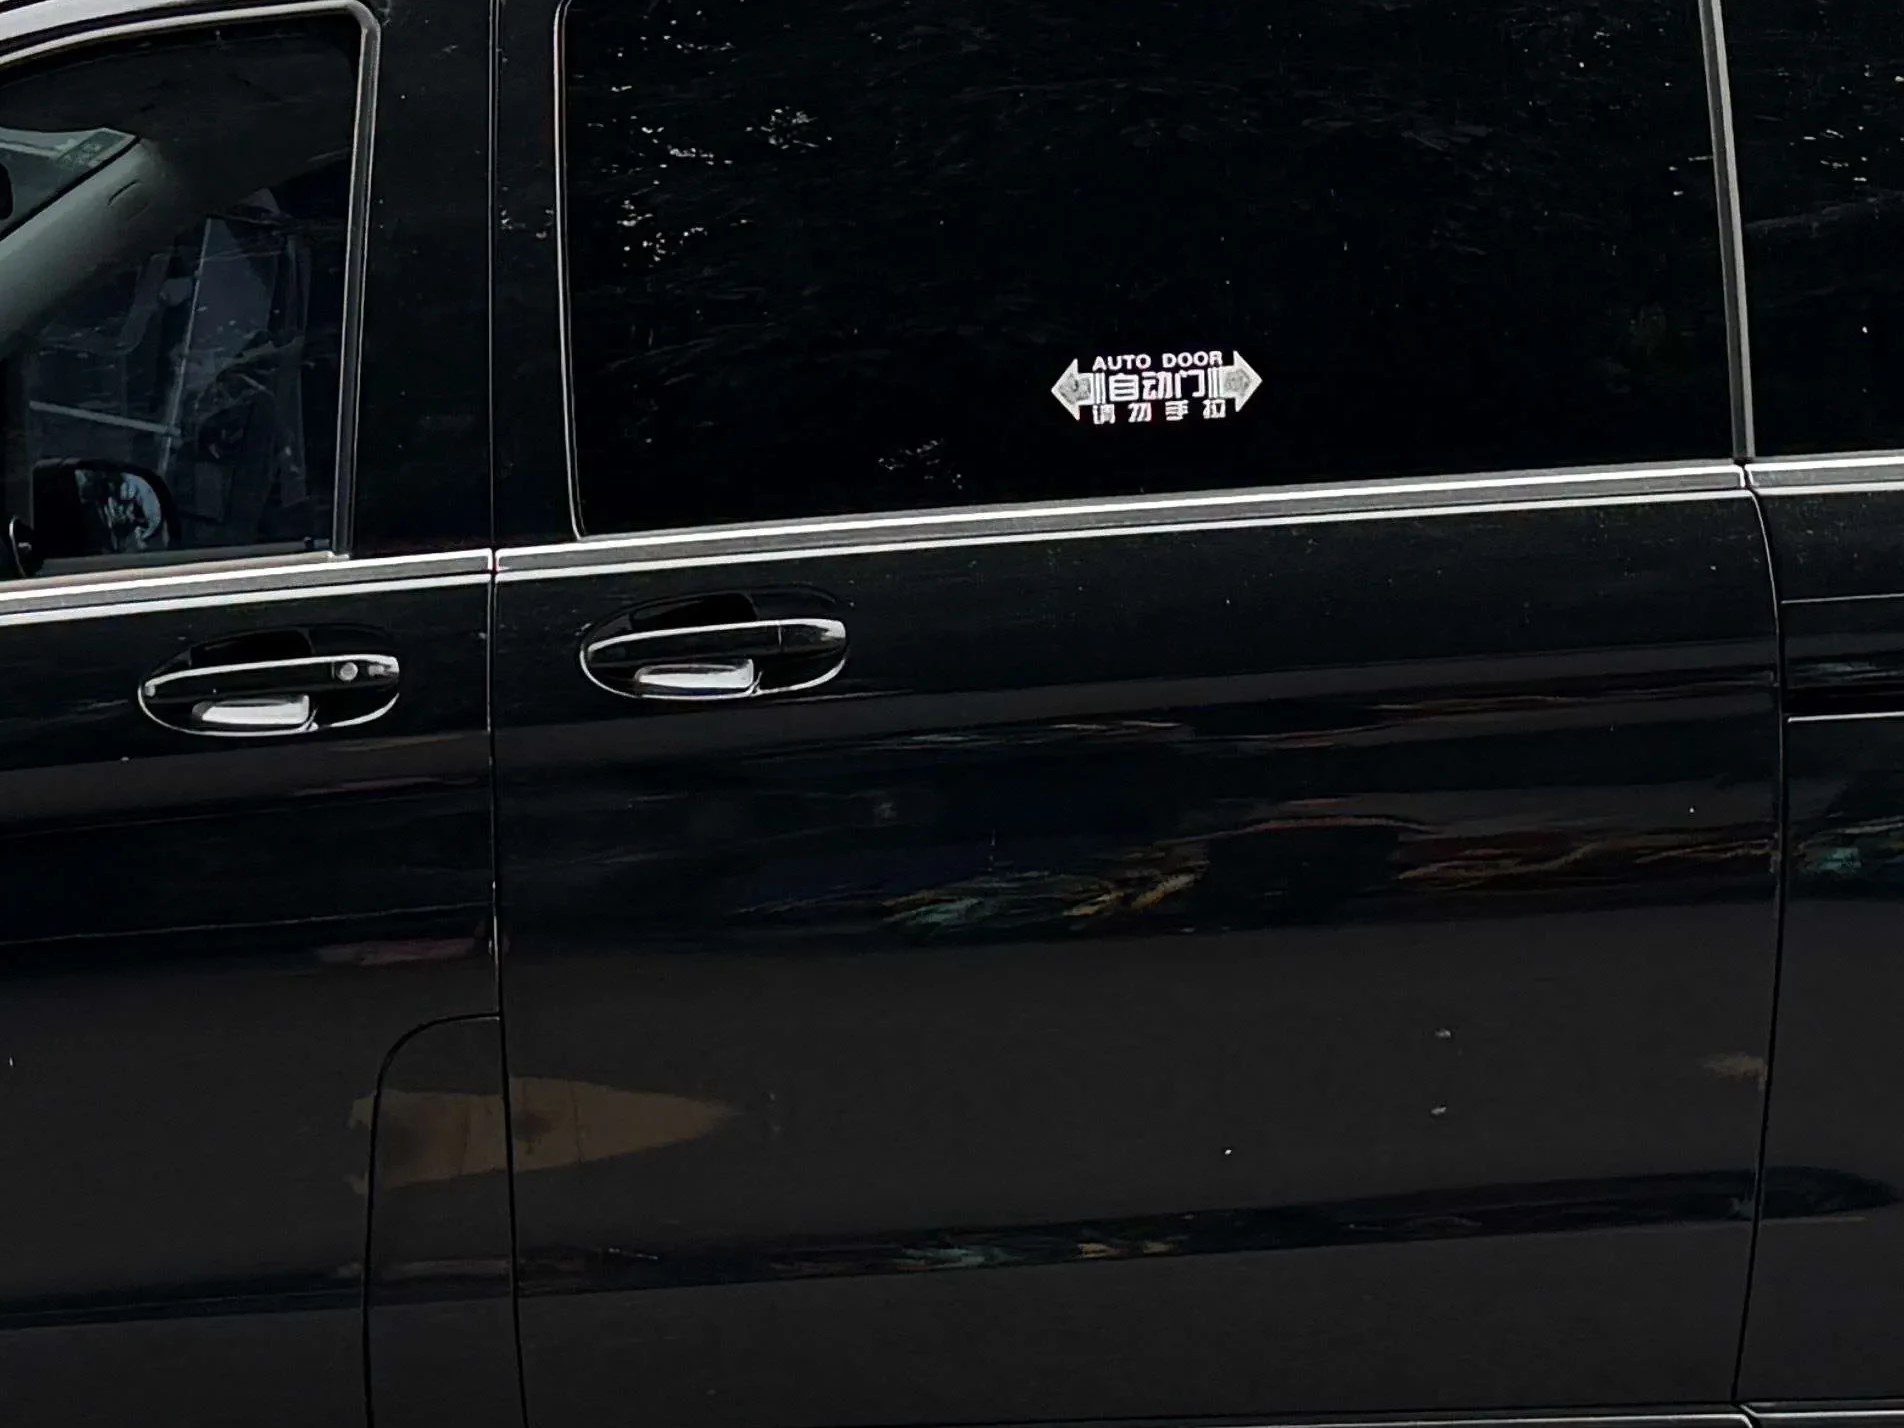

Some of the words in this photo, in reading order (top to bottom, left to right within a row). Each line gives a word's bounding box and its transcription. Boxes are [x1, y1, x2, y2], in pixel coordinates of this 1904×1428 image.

[1092, 354, 1152, 371] AUTO
[1162, 350, 1223, 368] DOOR
[1108, 369, 1205, 402] 自动门
